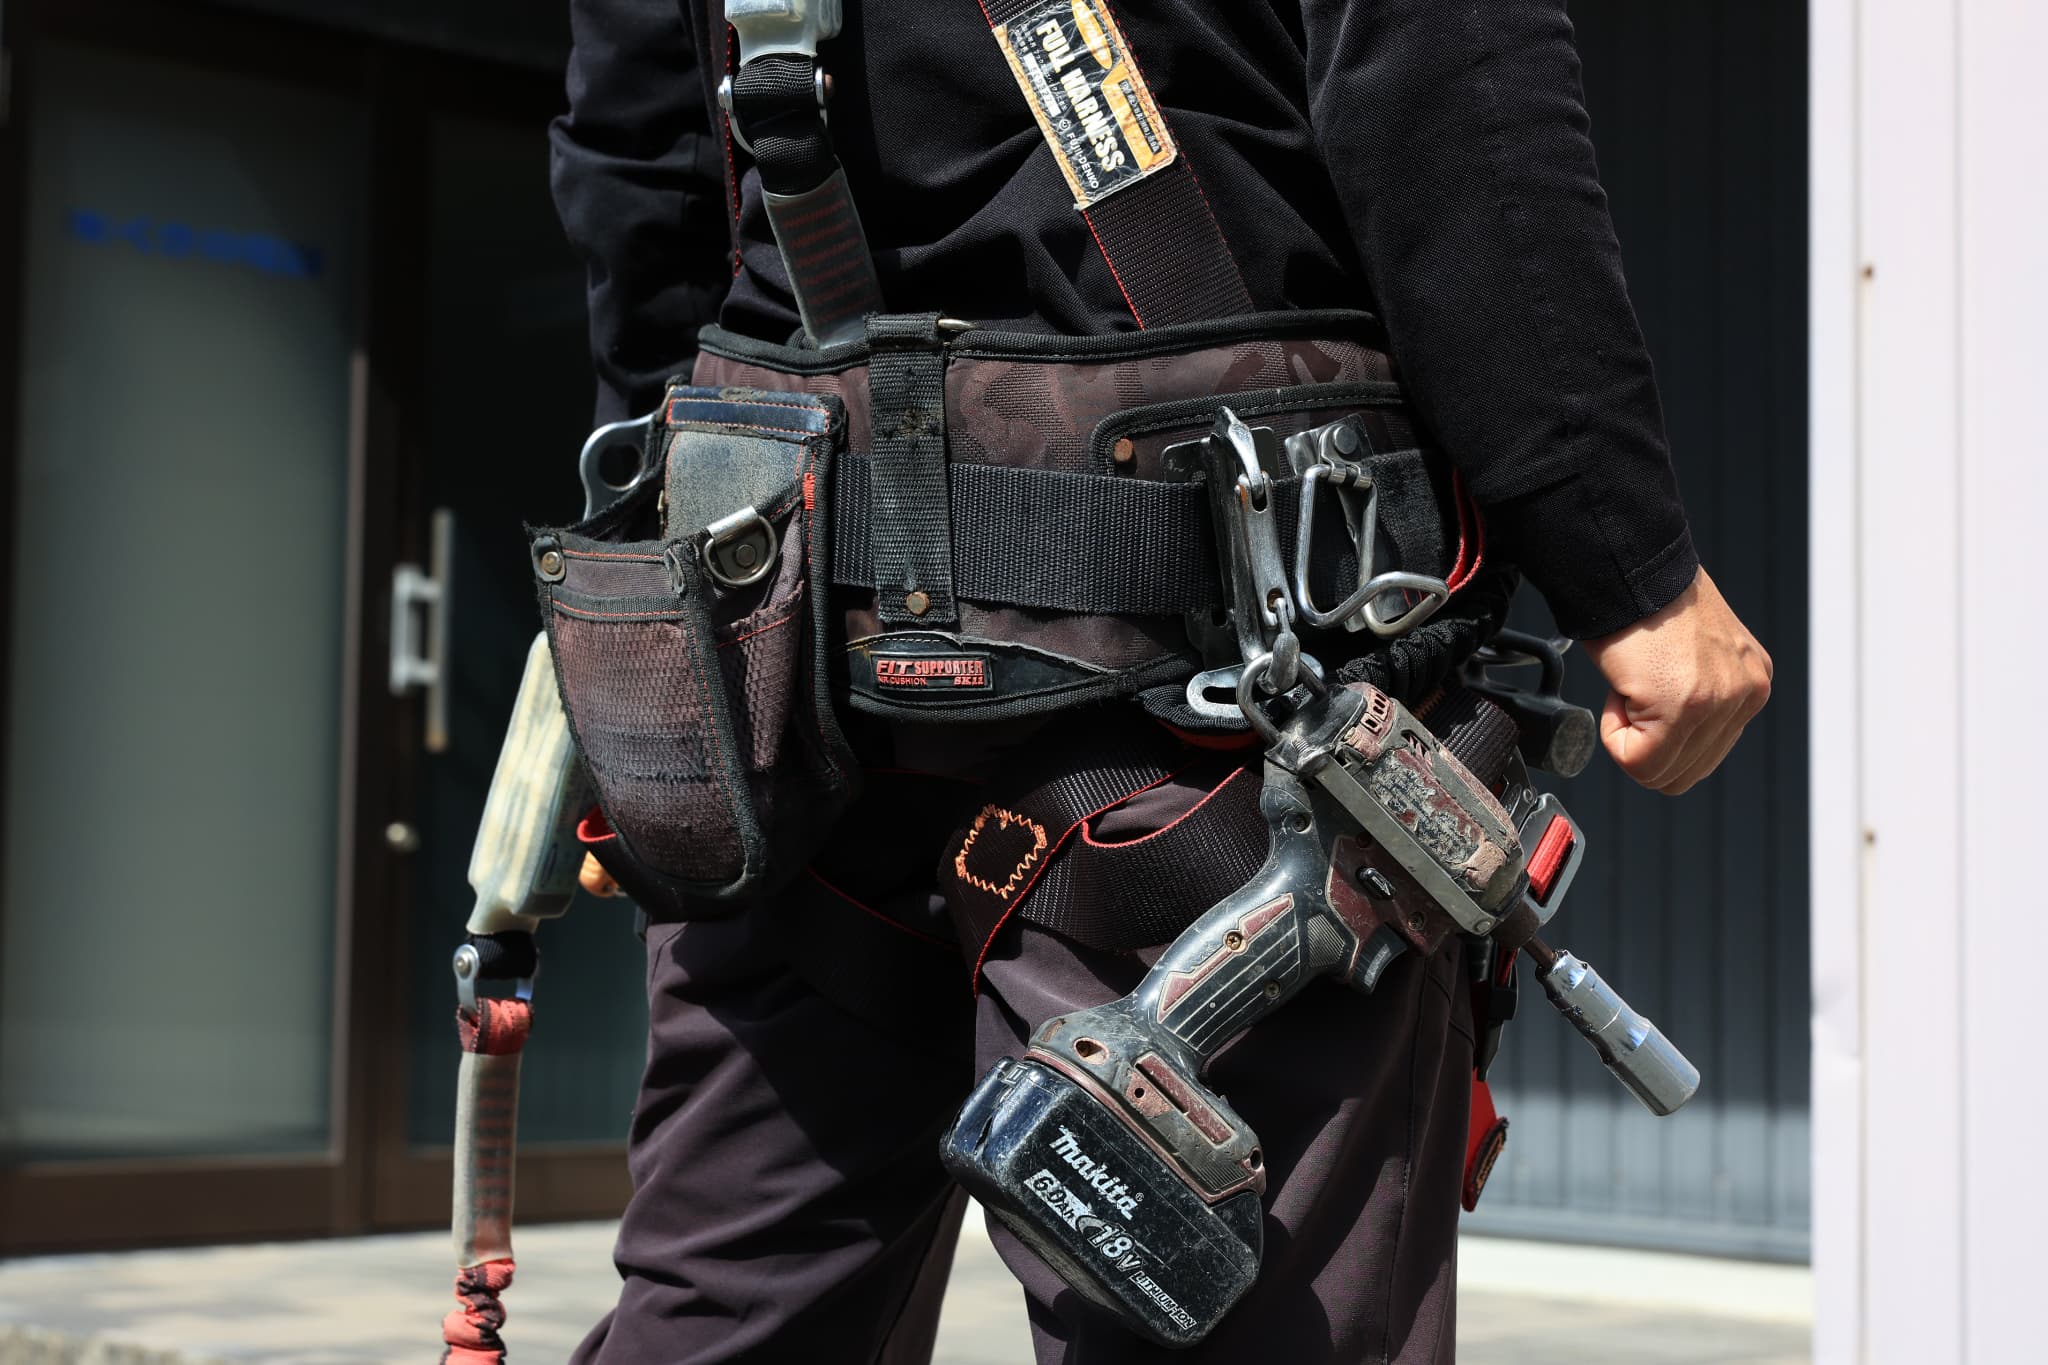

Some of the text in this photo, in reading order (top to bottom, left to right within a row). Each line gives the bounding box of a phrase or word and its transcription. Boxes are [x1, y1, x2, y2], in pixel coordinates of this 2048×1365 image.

[1036, 18, 1075, 73] FULL
[1060, 67, 1125, 172] HARNESS
[876, 660, 983, 675] FIT SUPPORTER
[890, 676, 928, 686] CUSHION
